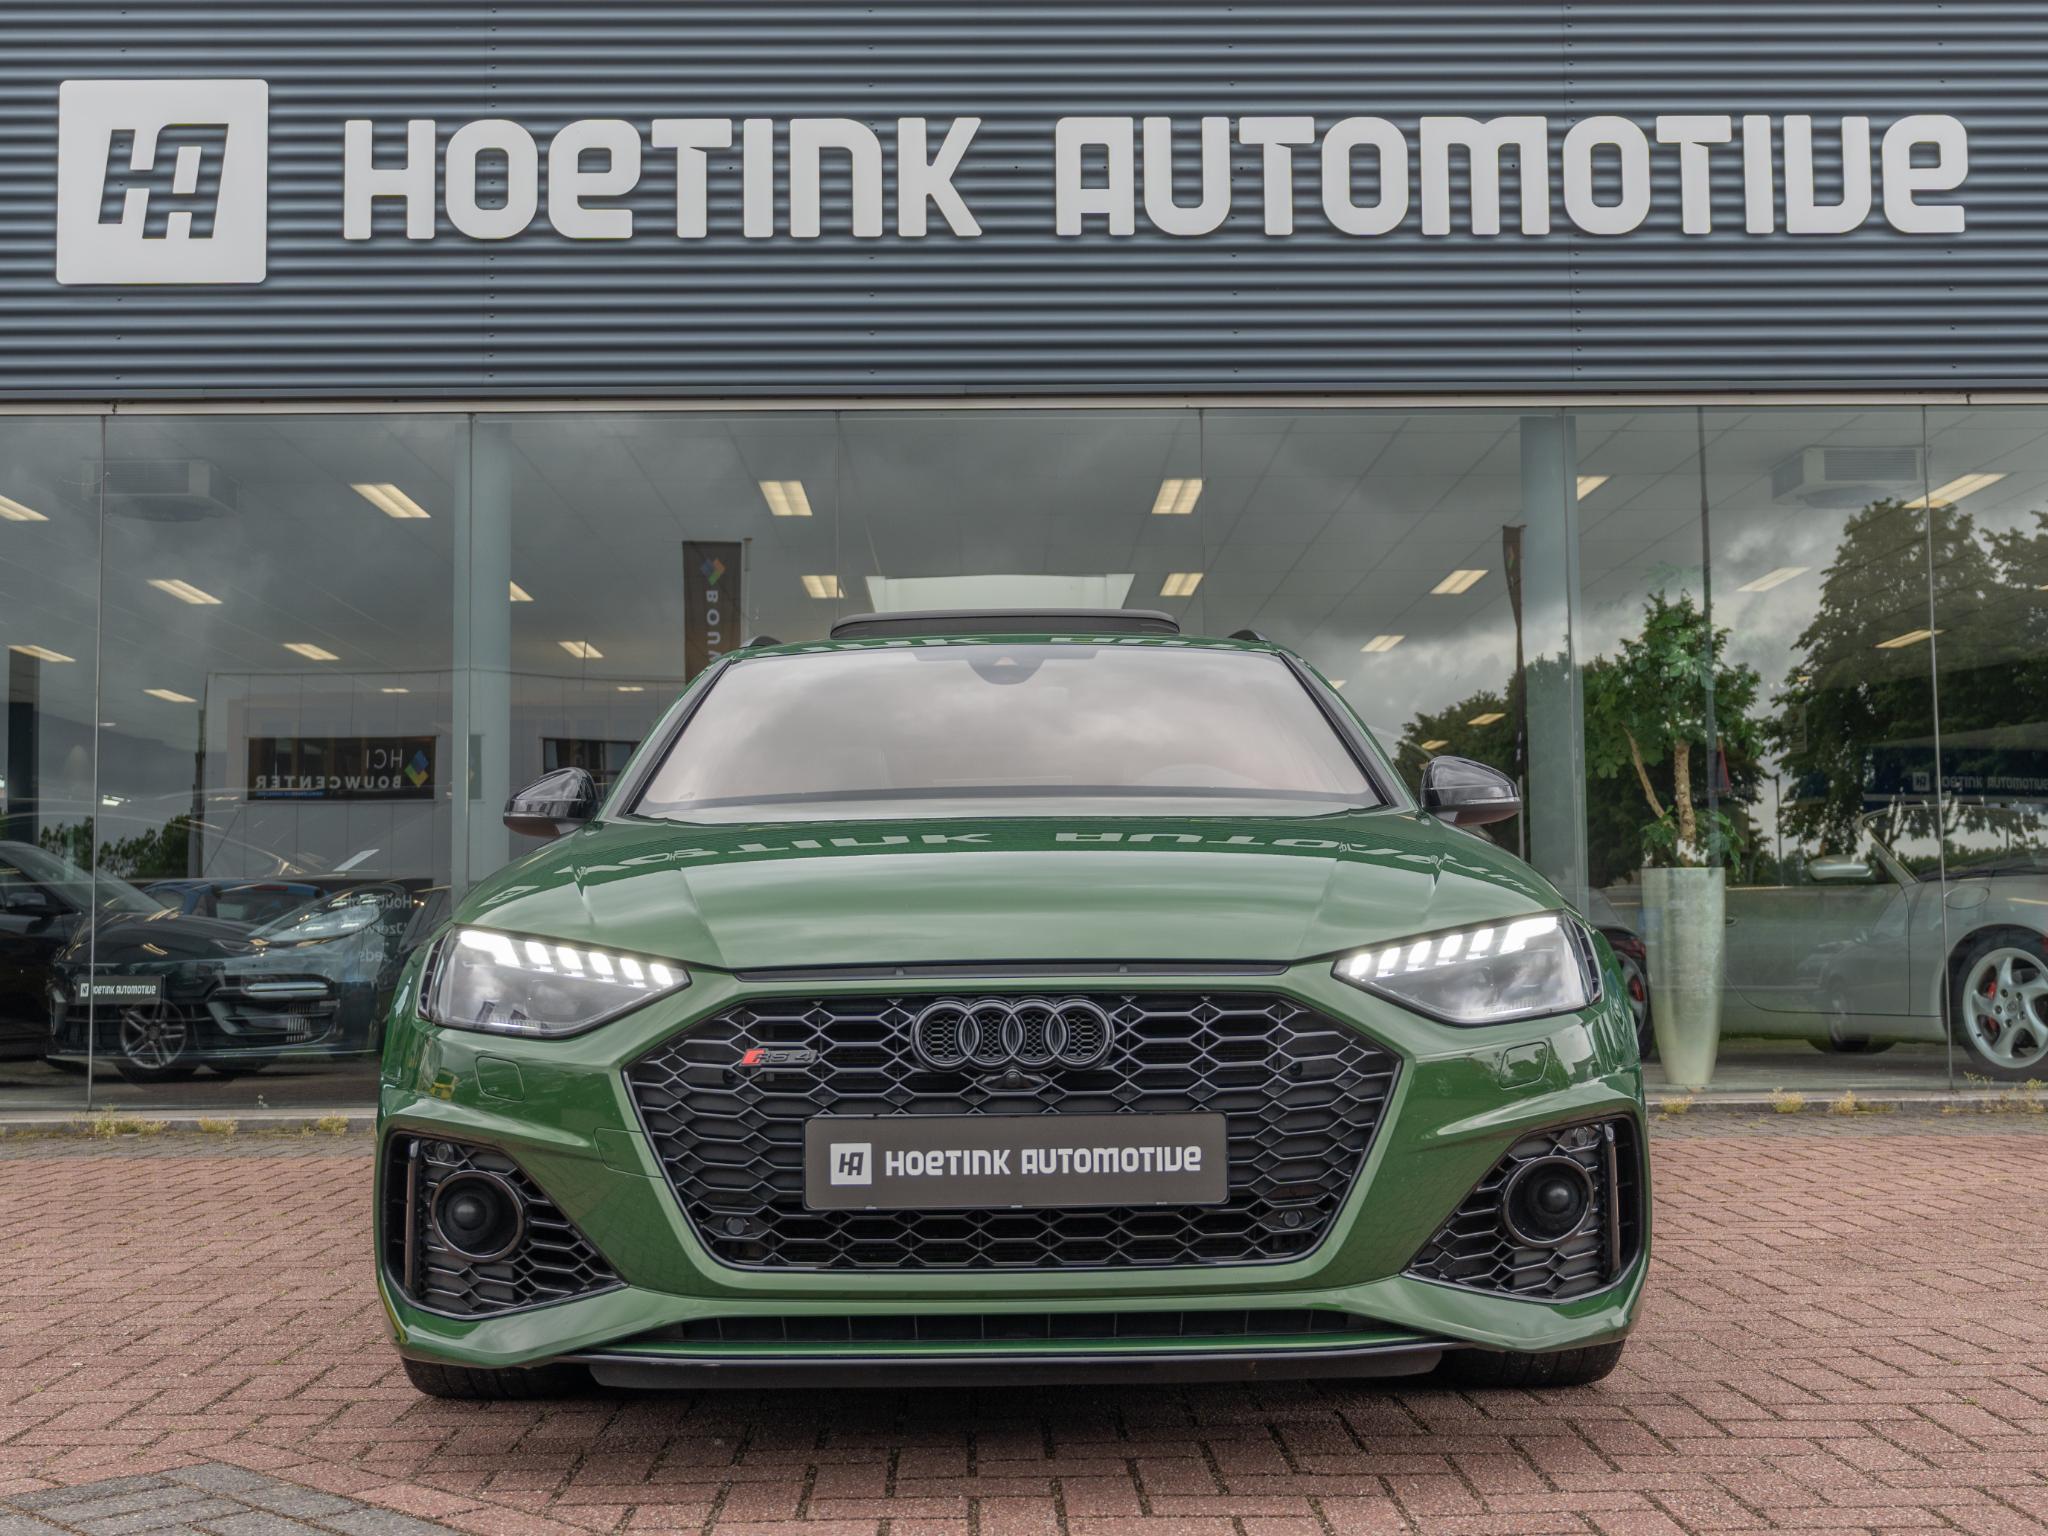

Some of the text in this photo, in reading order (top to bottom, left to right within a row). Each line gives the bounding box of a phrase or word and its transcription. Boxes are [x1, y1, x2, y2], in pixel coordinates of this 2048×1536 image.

[342, 114, 1969, 240] HOETINK AUTOMOTIVE
[885, 1149, 1011, 1176] HOETINK
[1021, 1145, 1202, 1175] AUTOMOTIVE
